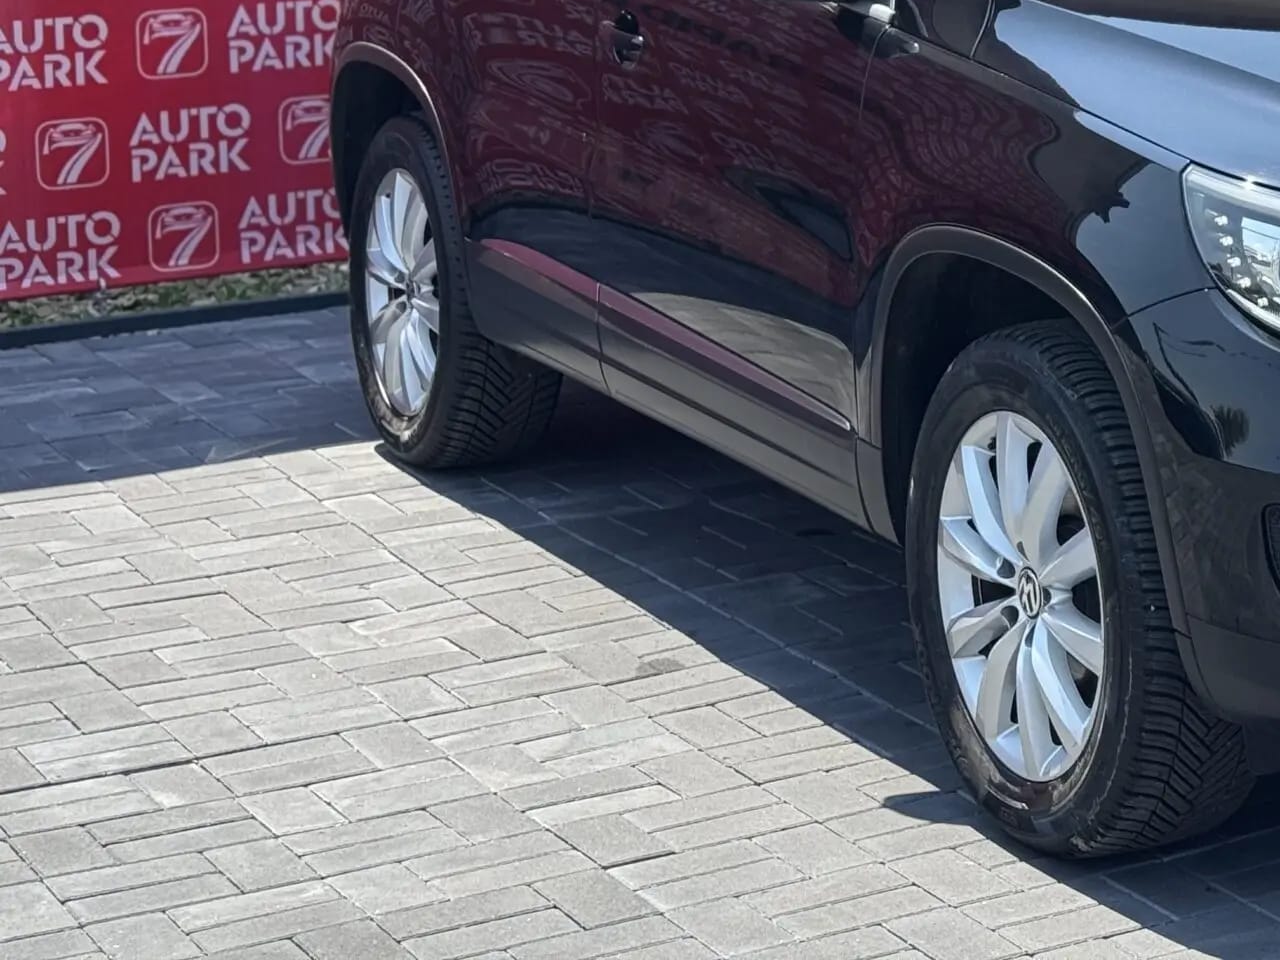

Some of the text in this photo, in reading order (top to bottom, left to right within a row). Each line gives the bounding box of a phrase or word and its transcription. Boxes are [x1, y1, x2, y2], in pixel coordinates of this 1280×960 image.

[129, 103, 251, 147] AUTO
[131, 137, 251, 183] PARK
[0, 210, 121, 252] AUTO
[240, 221, 350, 264] PARK
